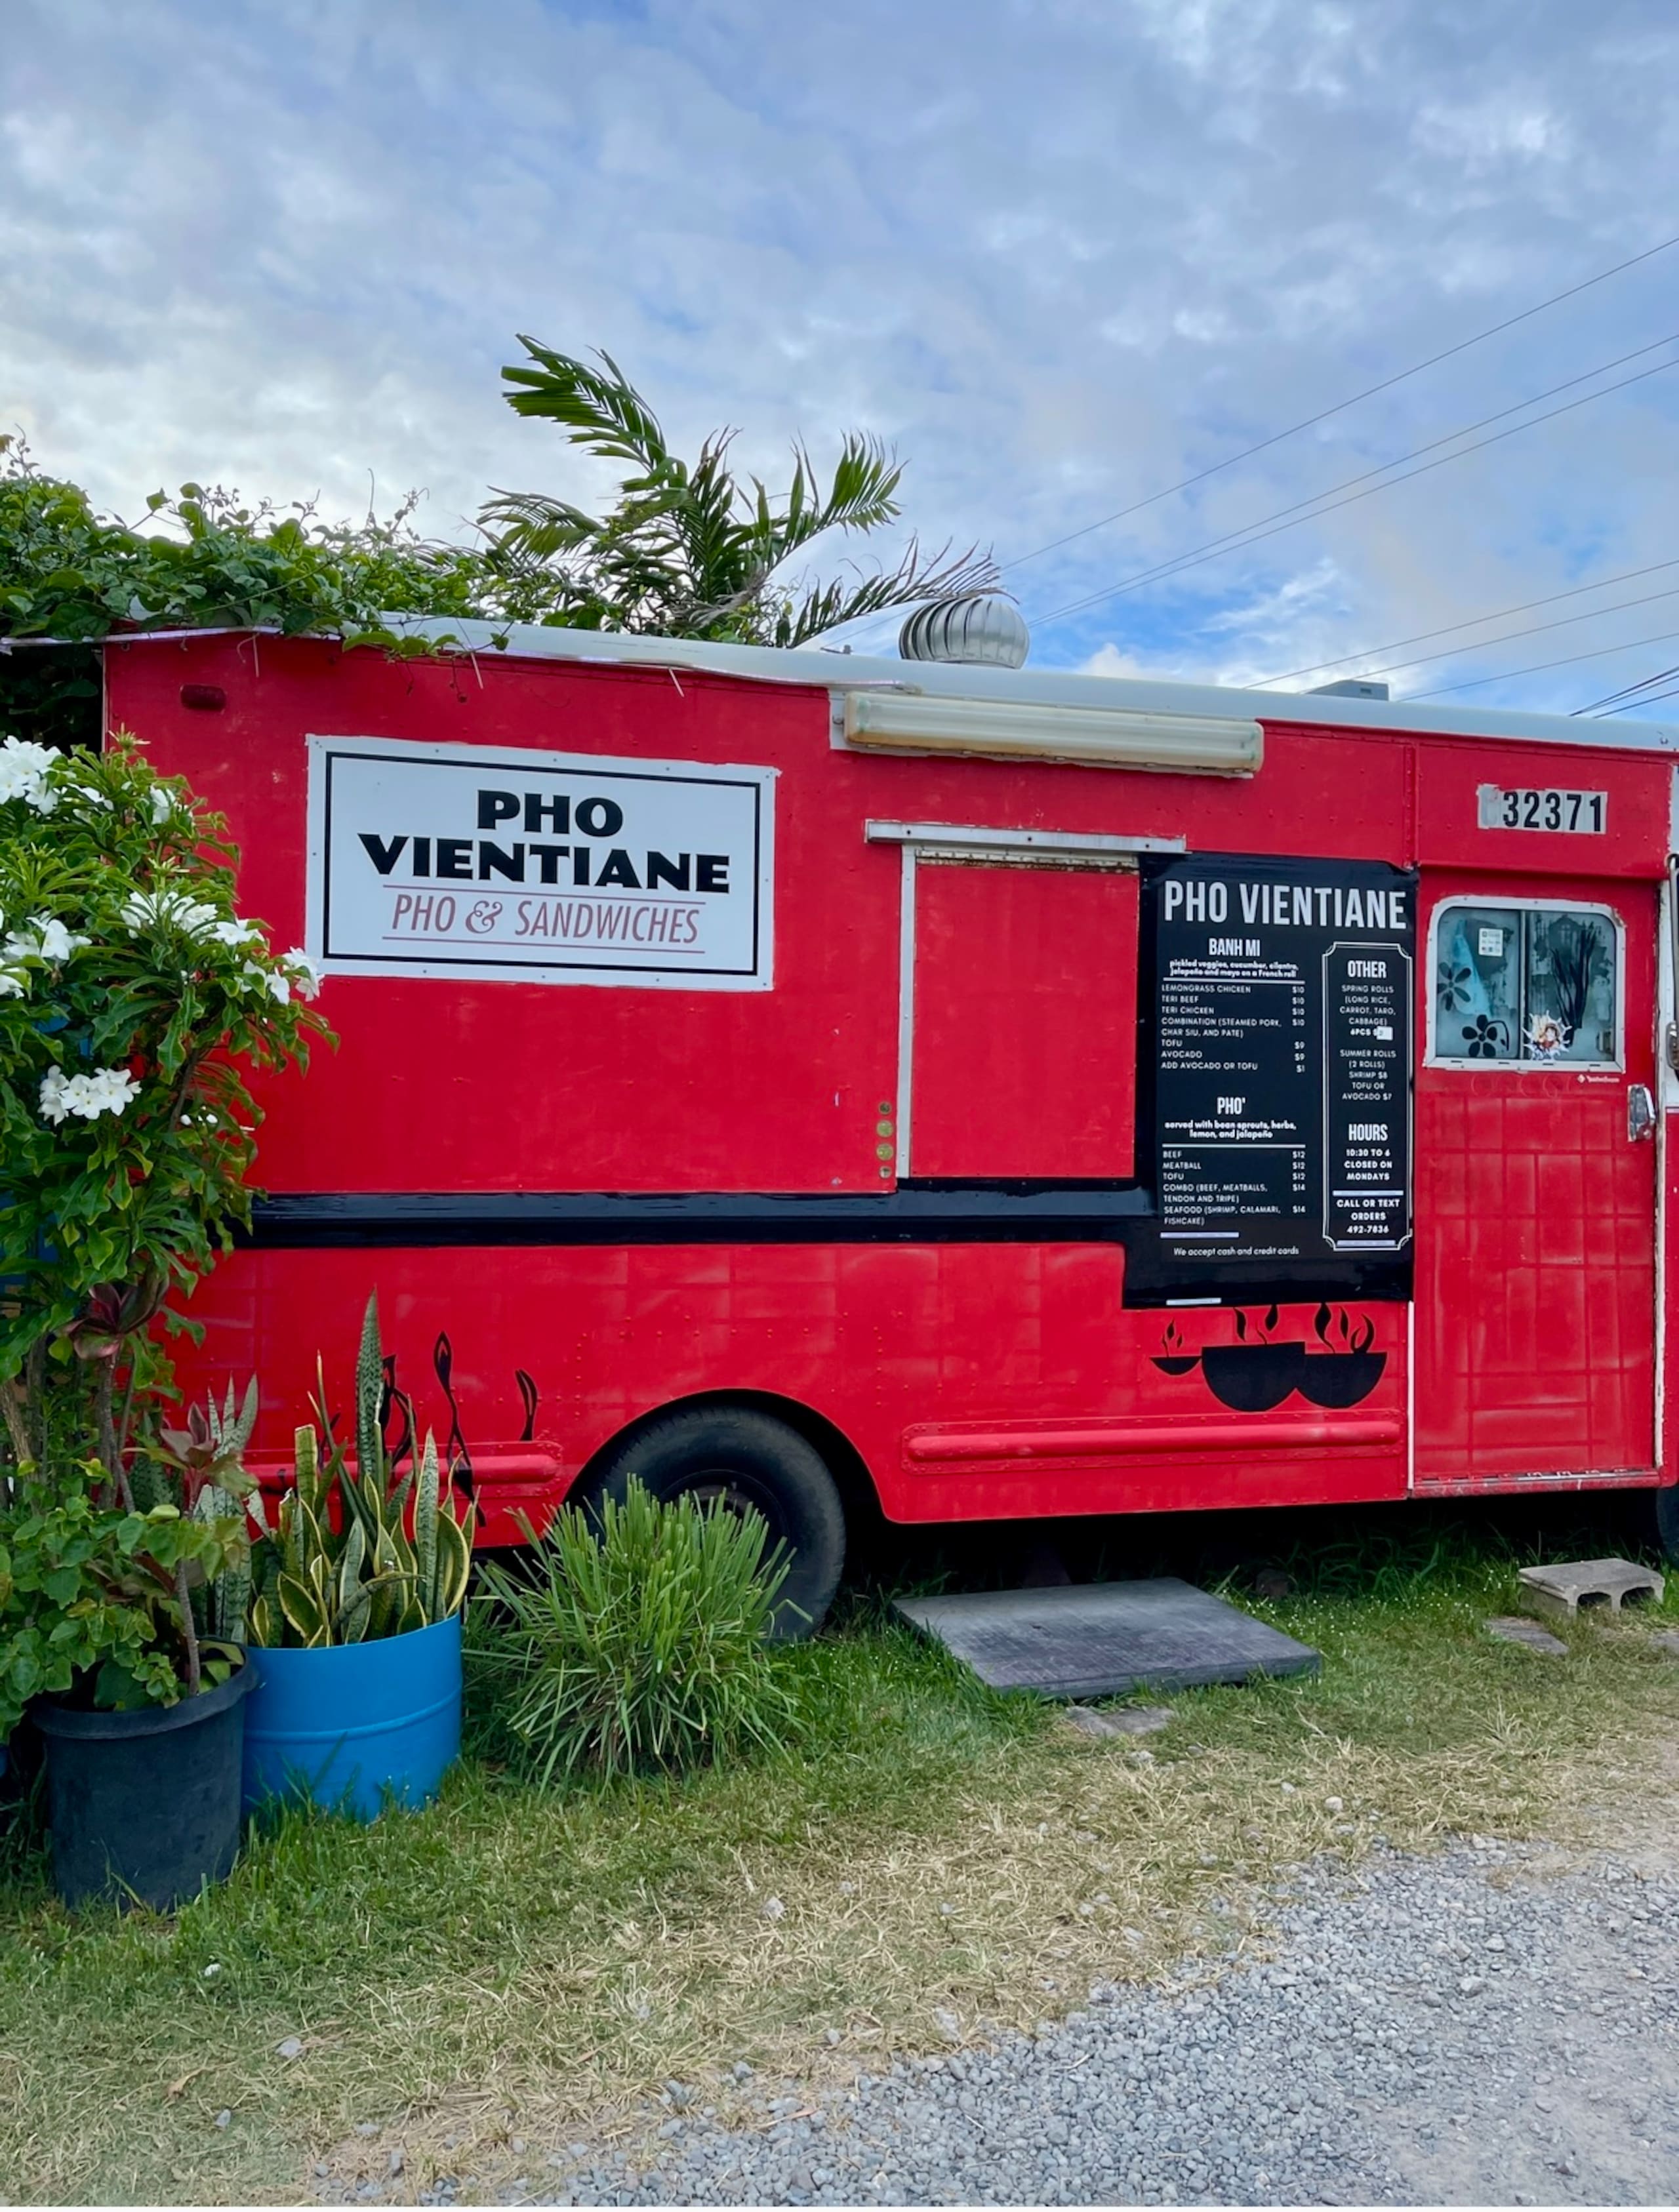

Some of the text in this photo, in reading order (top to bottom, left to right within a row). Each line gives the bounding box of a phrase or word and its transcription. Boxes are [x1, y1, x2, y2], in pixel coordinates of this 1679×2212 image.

[477, 789, 624, 837] PHO
[1503, 791, 1602, 832] 32371
[357, 832, 730, 894] VIENTIANE
[1164, 880, 1407, 929] PHO VIENTIANE
[391, 893, 699, 944] PHO & SANDWICHES
[1209, 938, 1261, 957] BANH MI
[1169, 959, 1198, 969] pickled
[1198, 961, 1229, 971] veggies,
[1230, 961, 1268, 970] cucumber,
[1347, 960, 1387, 978] OTHER
[1162, 984, 1215, 993] LEMONGRASS
[1217, 985, 1251, 994] CHICKEN
[1341, 984, 1394, 994] SPRING ROLLS
[1180, 995, 1199, 1003] BEEF
[1345, 995, 1391, 1005] (LONG RICE,
[1180, 1006, 1215, 1015] CHICKEN
[1374, 1007, 1396, 1015] TARO,
[1161, 1016, 1216, 1026] COMBINATION
[1218, 1018, 1257, 1027] (STEAMED
[1258, 1018, 1282, 1027] PORK,
[1348, 1017, 1387, 1026] CABBAGE)
[1221, 1030, 1244, 1039] PATE)
[1161, 1039, 1305, 1049] TOFU $9
[1161, 1050, 1203, 1058] AVOCADO
[1339, 1049, 1397, 1058] SUMMER ROLLS
[1161, 1061, 1178, 1070] ADD
[1180, 1062, 1222, 1070] AVOCADO
[1348, 1060, 1386, 1070] (2 ROLLS)
[1342, 1092, 1381, 1100] AVOCADO
[1217, 1097, 1246, 1115] PHO'
[1164, 1119, 1297, 1131] served with bean sprouts, herbs,
[1189, 1129, 1274, 1140] lemon, and jalapeño
[1348, 1123, 1388, 1141] HOURS
[1292, 1150, 1306, 1159] $12
[1346, 1148, 1369, 1157] 10:30
[1162, 1161, 1306, 1170] MEATBALL $12
[1344, 1160, 1378, 1169] CLOSED
[1292, 1172, 1306, 1180] $12
[1346, 1172, 1390, 1180] MONDAYS
[1196, 1184, 1221, 1193] (BEEF,
[1222, 1184, 1267, 1192] MEATBALLS,
[1292, 1183, 1306, 1192] $14
[1215, 1195, 1240, 1203] TRIPE)
[1336, 1199, 1400, 1208] CALL OR TEXT
[1204, 1206, 1238, 1215] (SHRIMP,
[1240, 1206, 1281, 1215] CALAMARI,
[1292, 1205, 1306, 1214] $14
[1350, 1212, 1386, 1220] ORDERS
[1164, 1217, 1205, 1226] FISHCAKE)
[1188, 1248, 1216, 1257] accept
[1237, 1247, 1253, 1255] and
[1253, 1246, 1276, 1255] credit
[1277, 1246, 1299, 1255] cards
